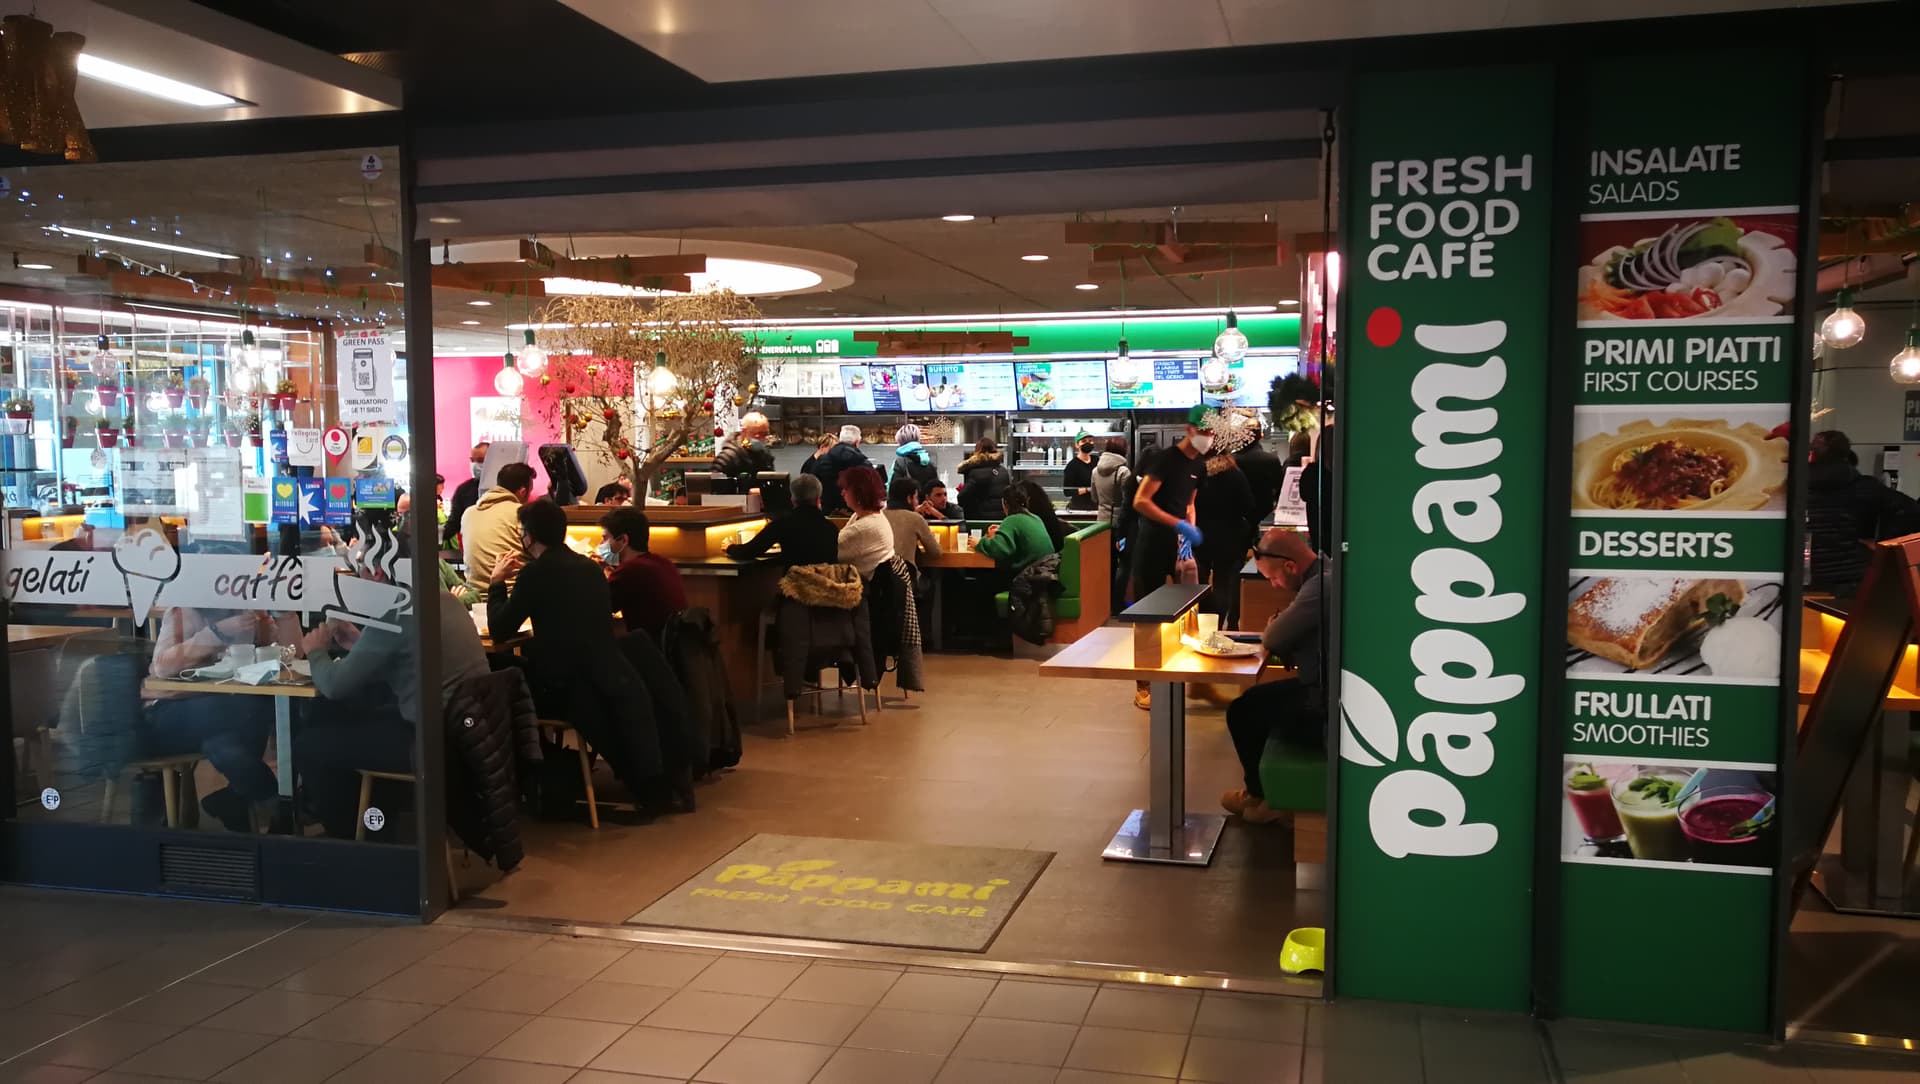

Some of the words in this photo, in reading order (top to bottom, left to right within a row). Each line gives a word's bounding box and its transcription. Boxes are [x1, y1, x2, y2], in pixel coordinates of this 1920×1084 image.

[1591, 143, 1741, 176] INSALATE
[1370, 153, 1533, 198] FRESH
[1588, 180, 1680, 205] SALADS
[1370, 198, 1520, 240] FOOD
[1367, 231, 1495, 281] CAFÉ
[1585, 338, 1674, 365] PRIMI
[1685, 336, 1781, 363] PIATTI
[1584, 371, 1641, 392] FIRST
[1647, 370, 1759, 391] COURSES
[1579, 531, 1734, 559] DESSERTS
[6, 556, 95, 600] gelati
[1574, 691, 1711, 721] FRULLATI
[1573, 723, 1709, 747] SMOOTHIES
[690, 888, 789, 903] FRESH
[800, 896, 893, 910] FOOD
